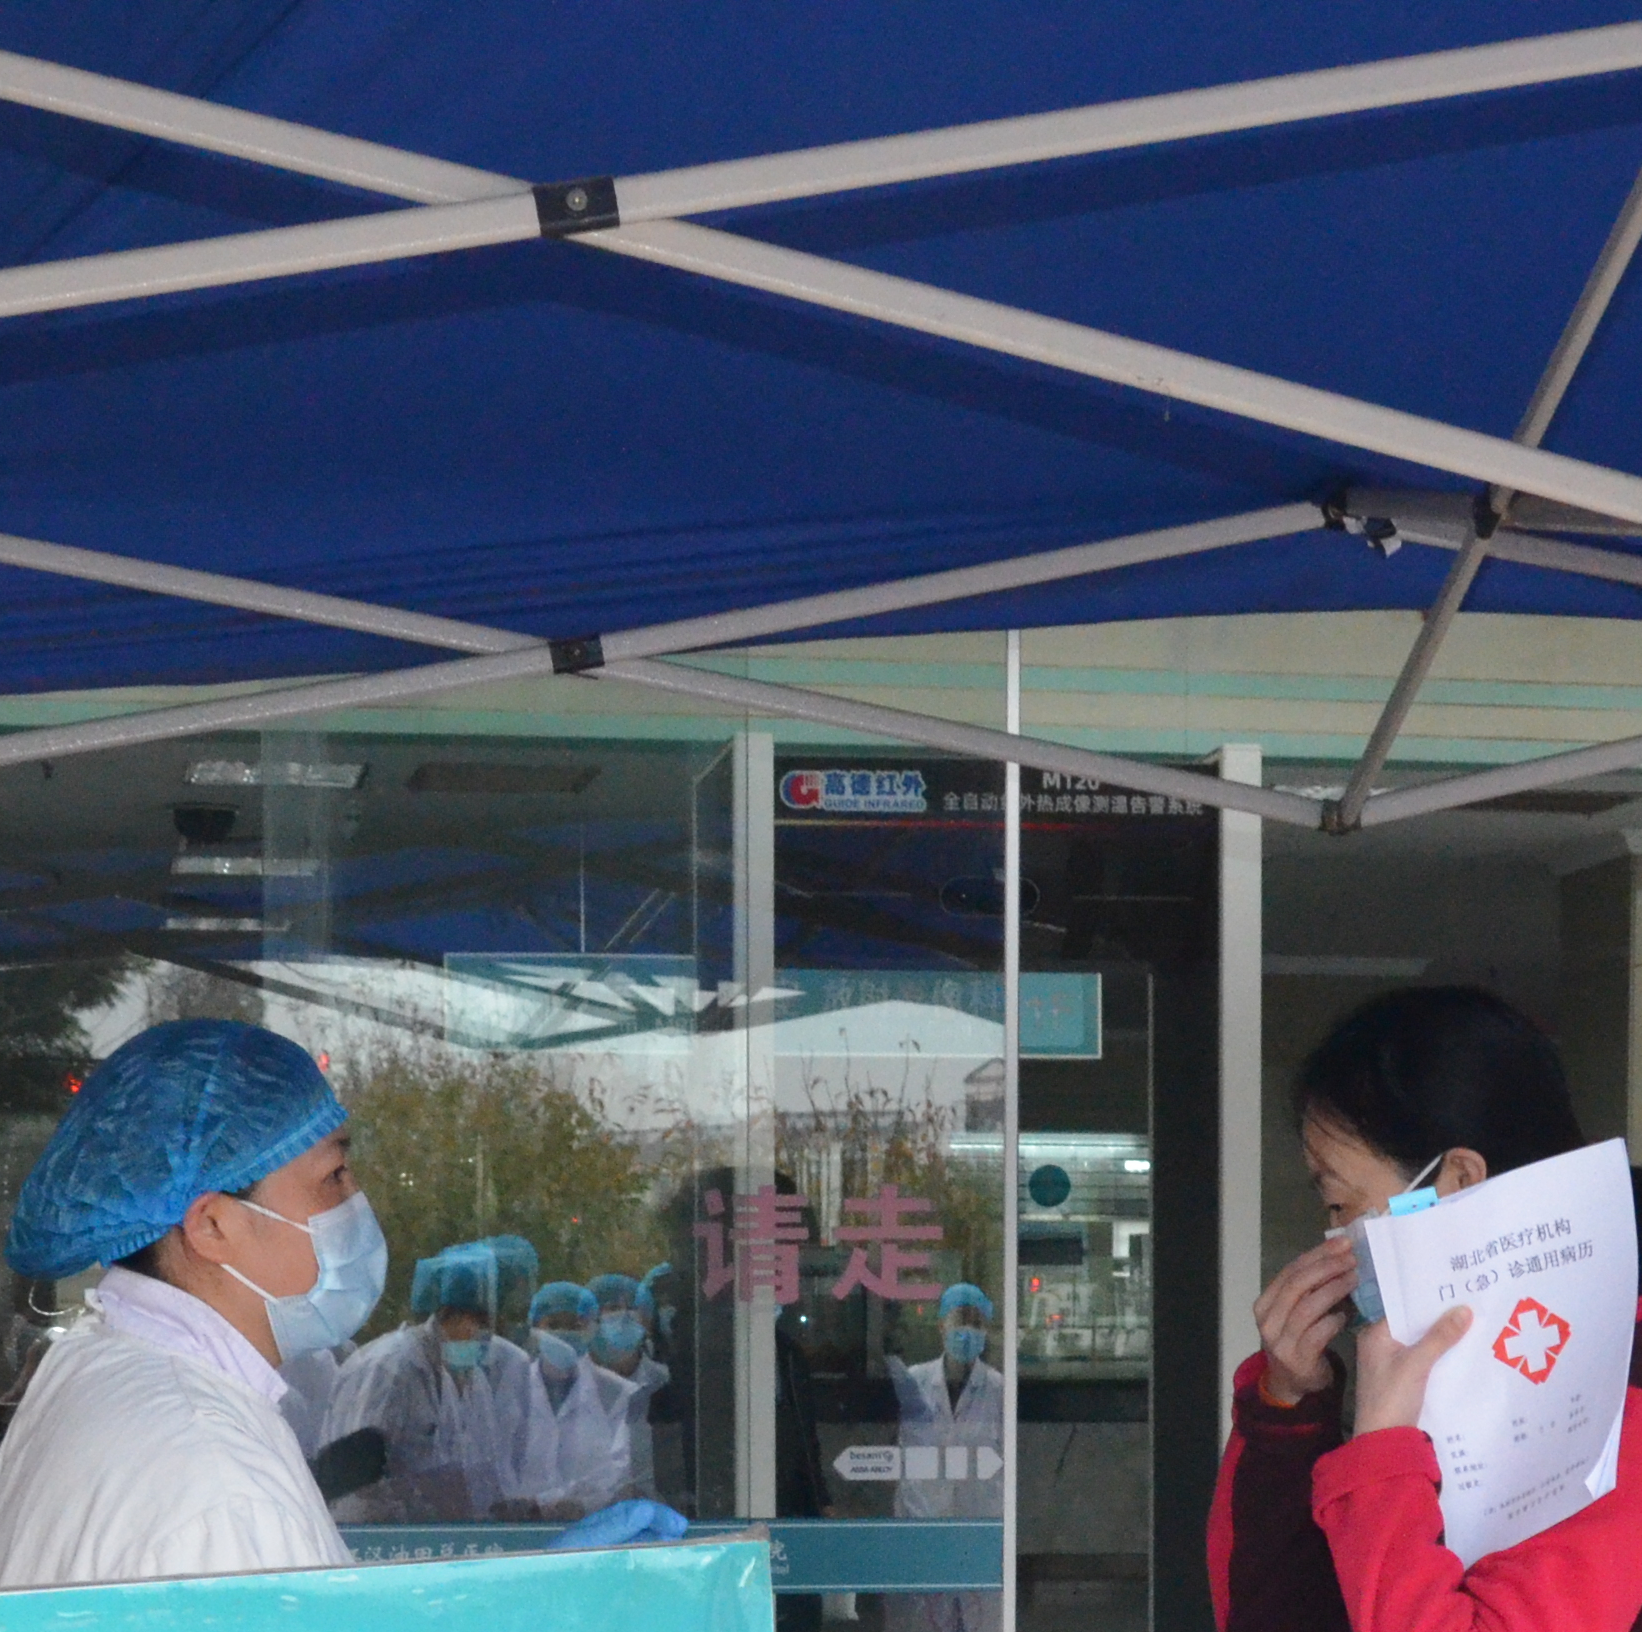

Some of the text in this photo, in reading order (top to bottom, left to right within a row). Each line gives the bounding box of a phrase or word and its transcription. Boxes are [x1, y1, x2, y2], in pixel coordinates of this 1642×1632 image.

[825, 771, 926, 797] 高德红外
[693, 1185, 944, 1305] 请走
[1449, 1217, 1572, 1272] 湖北省医疗机构
